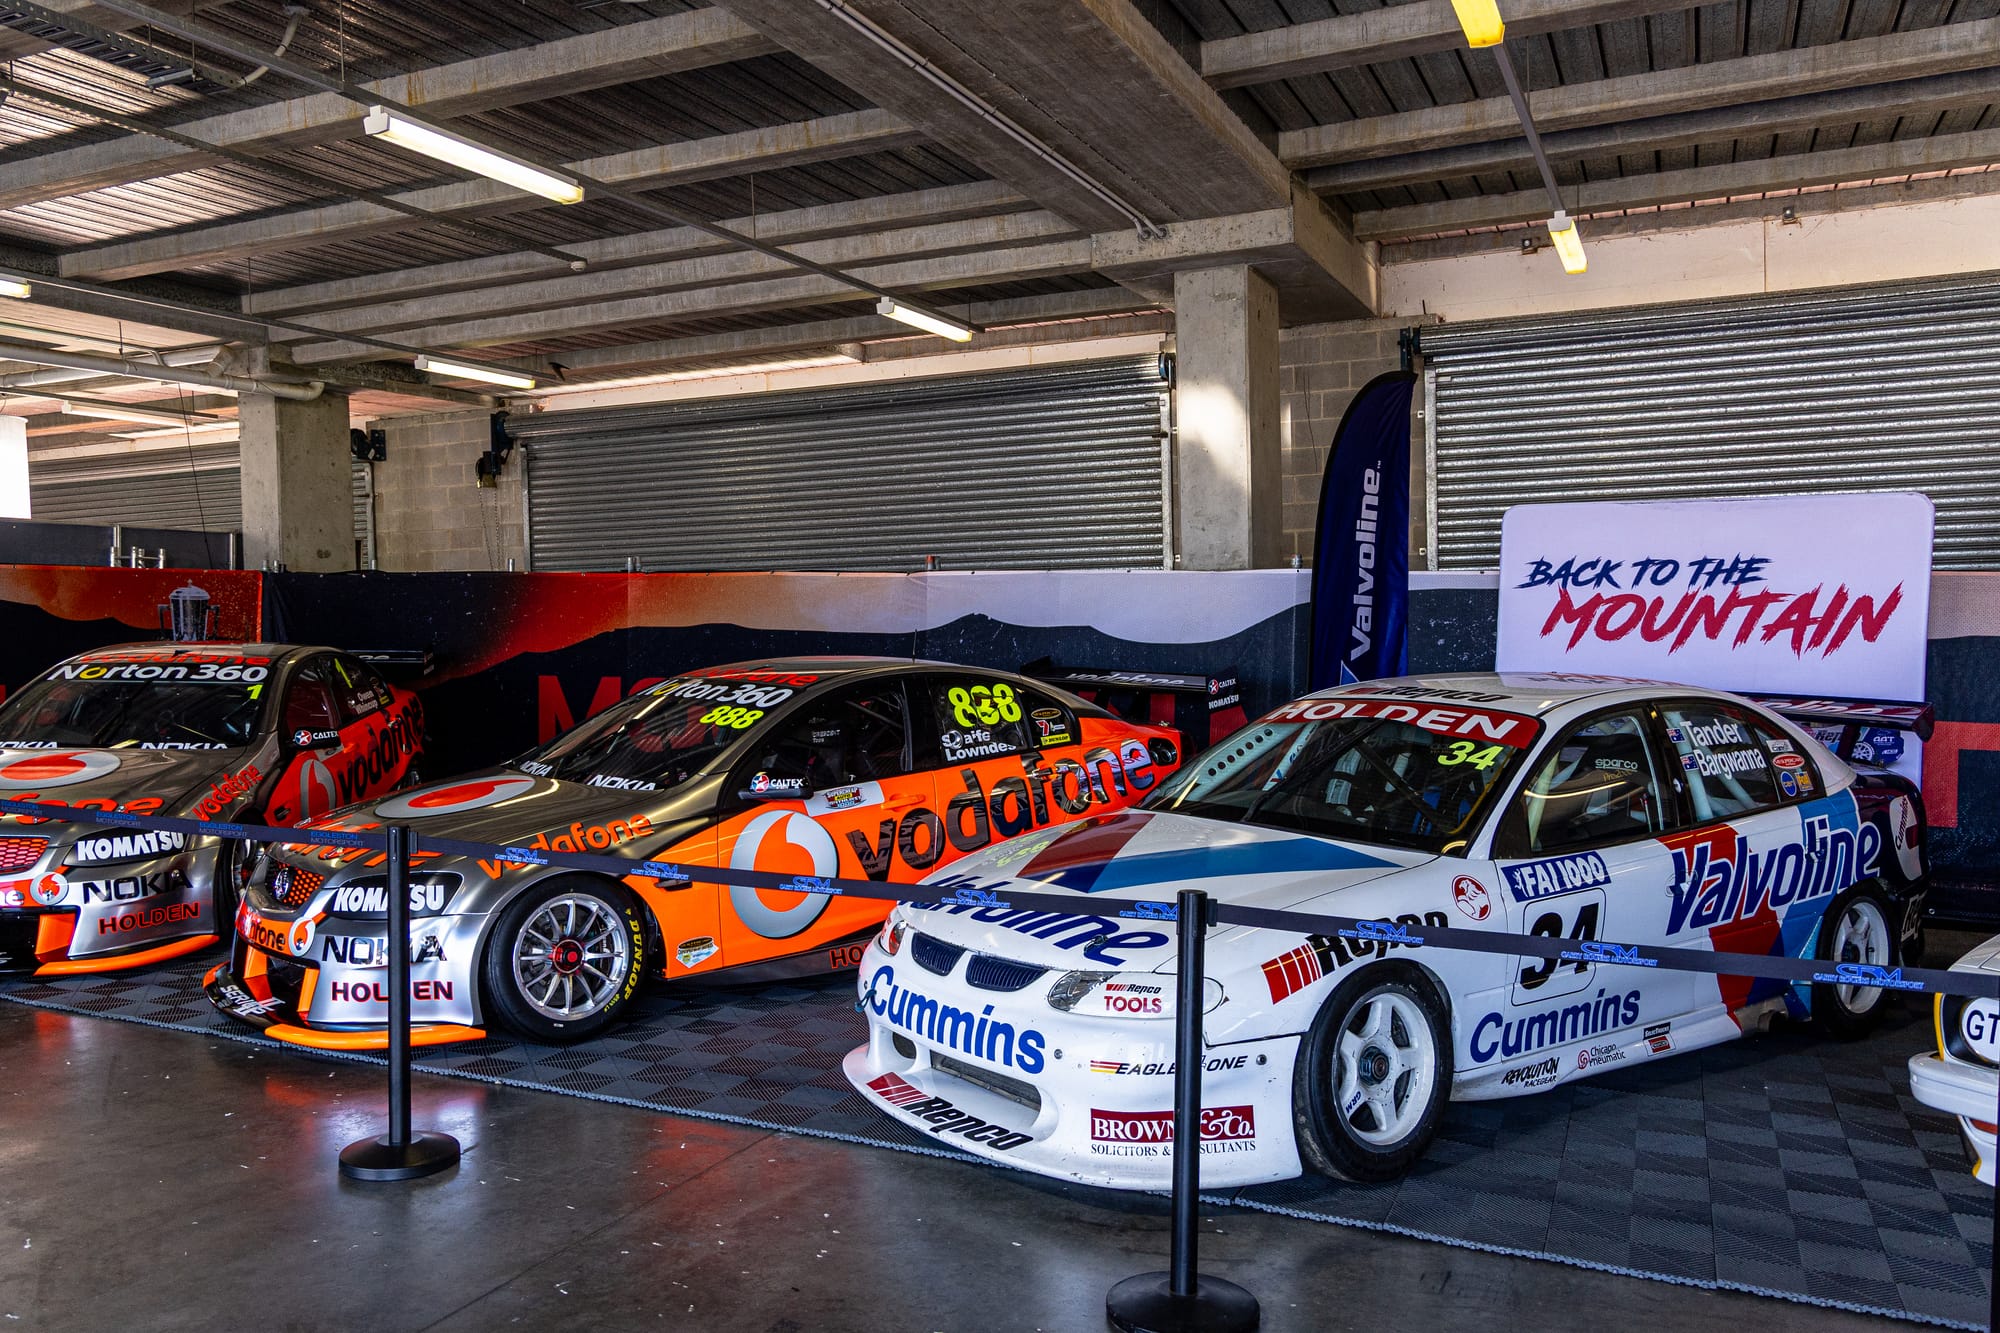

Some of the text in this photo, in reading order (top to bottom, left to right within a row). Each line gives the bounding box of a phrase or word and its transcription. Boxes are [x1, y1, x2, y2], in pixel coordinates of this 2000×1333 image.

[1350, 467, 1381, 661] Valvoline
[1514, 552, 1776, 590] BACK TO THE
[1540, 579, 1904, 661] MOUNTAIN
[48, 663, 268, 683] Norton 360
[246, 684, 263, 700] 1
[716, 684, 794, 708] 360
[700, 705, 765, 730] 888
[1265, 701, 1519, 740] HOLDEN
[941, 730, 991, 748] Saife
[1680, 718, 1743, 748] Tander
[1815, 729, 1843, 743] Rep
[945, 742, 1017, 762] Lowndes
[1437, 740, 1504, 771] 34
[1595, 757, 1638, 771] sparco
[1693, 747, 1767, 780] Bargwanna
[192, 764, 264, 822] vodafone
[587, 774, 656, 791] NOKIA
[770, 778, 804, 788] CALTEX
[846, 737, 1155, 883] vodafone
[77, 830, 184, 862] KOMATSU
[83, 869, 195, 905] NOKIA
[1665, 814, 1882, 937] Valvoline
[333, 884, 445, 912] KOMSU
[99, 902, 201, 935] HOLDEN
[321, 935, 448, 965] NOA
[623, 919, 643, 1001] DUNLOP
[331, 981, 453, 1001] HOLEN
[1127, 983, 1162, 995] Repco
[1103, 995, 1162, 1014] TOOLS
[870, 965, 1046, 1075] Cummins
[1470, 988, 1641, 1063] Cummins
[1590, 1043, 1617, 1056] Chicago
[1501, 1057, 1560, 1085] REVOLUTION
[1523, 1075, 1557, 1088] RACEGEAR
[900, 1095, 1034, 1151] Repco
[1090, 1140, 1256, 1157] SOLICITORS & SULTANTS
